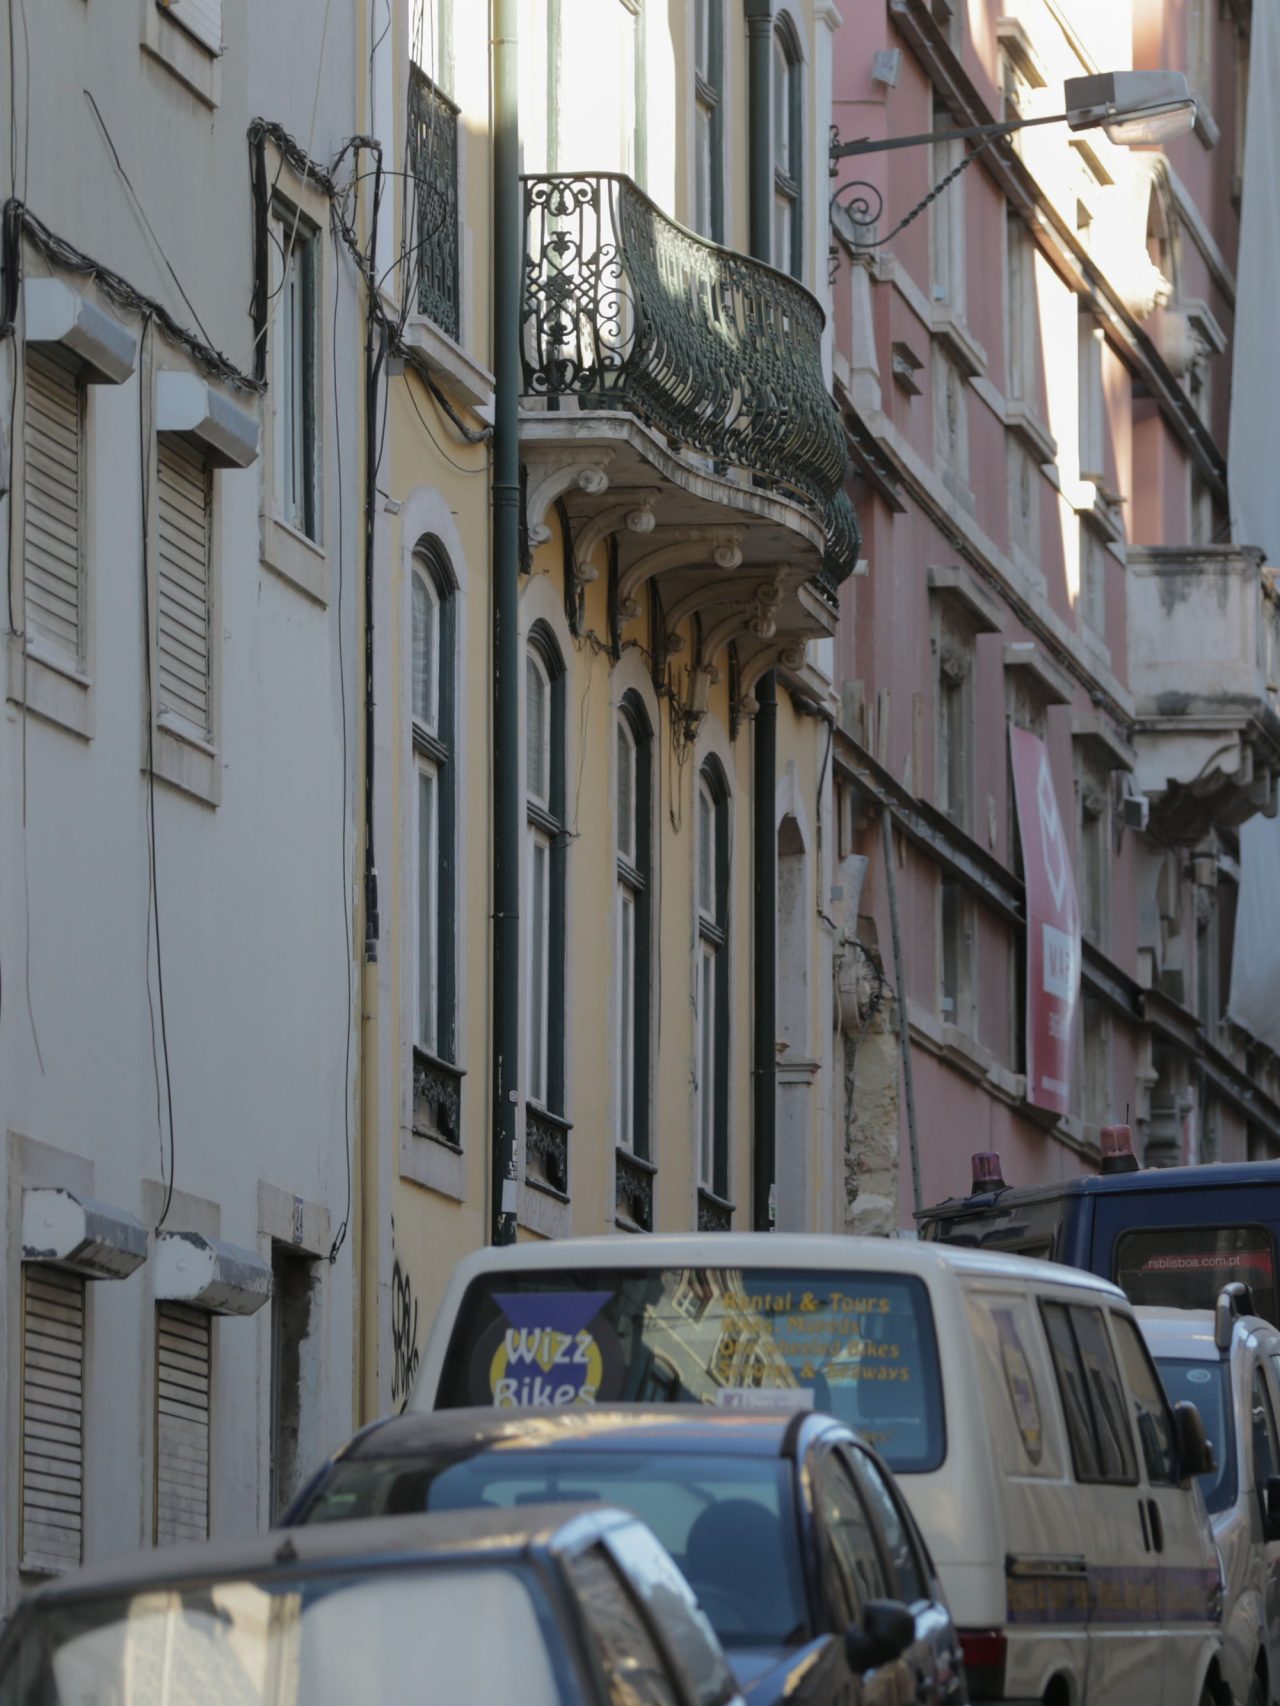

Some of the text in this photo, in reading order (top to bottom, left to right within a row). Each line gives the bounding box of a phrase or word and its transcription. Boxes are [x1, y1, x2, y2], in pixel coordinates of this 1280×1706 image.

[800, 1291, 817, 1312] &
[830, 1292, 890, 1313] Tours
[505, 1327, 593, 1365] Wizz
[494, 1376, 597, 1408] Bikes
